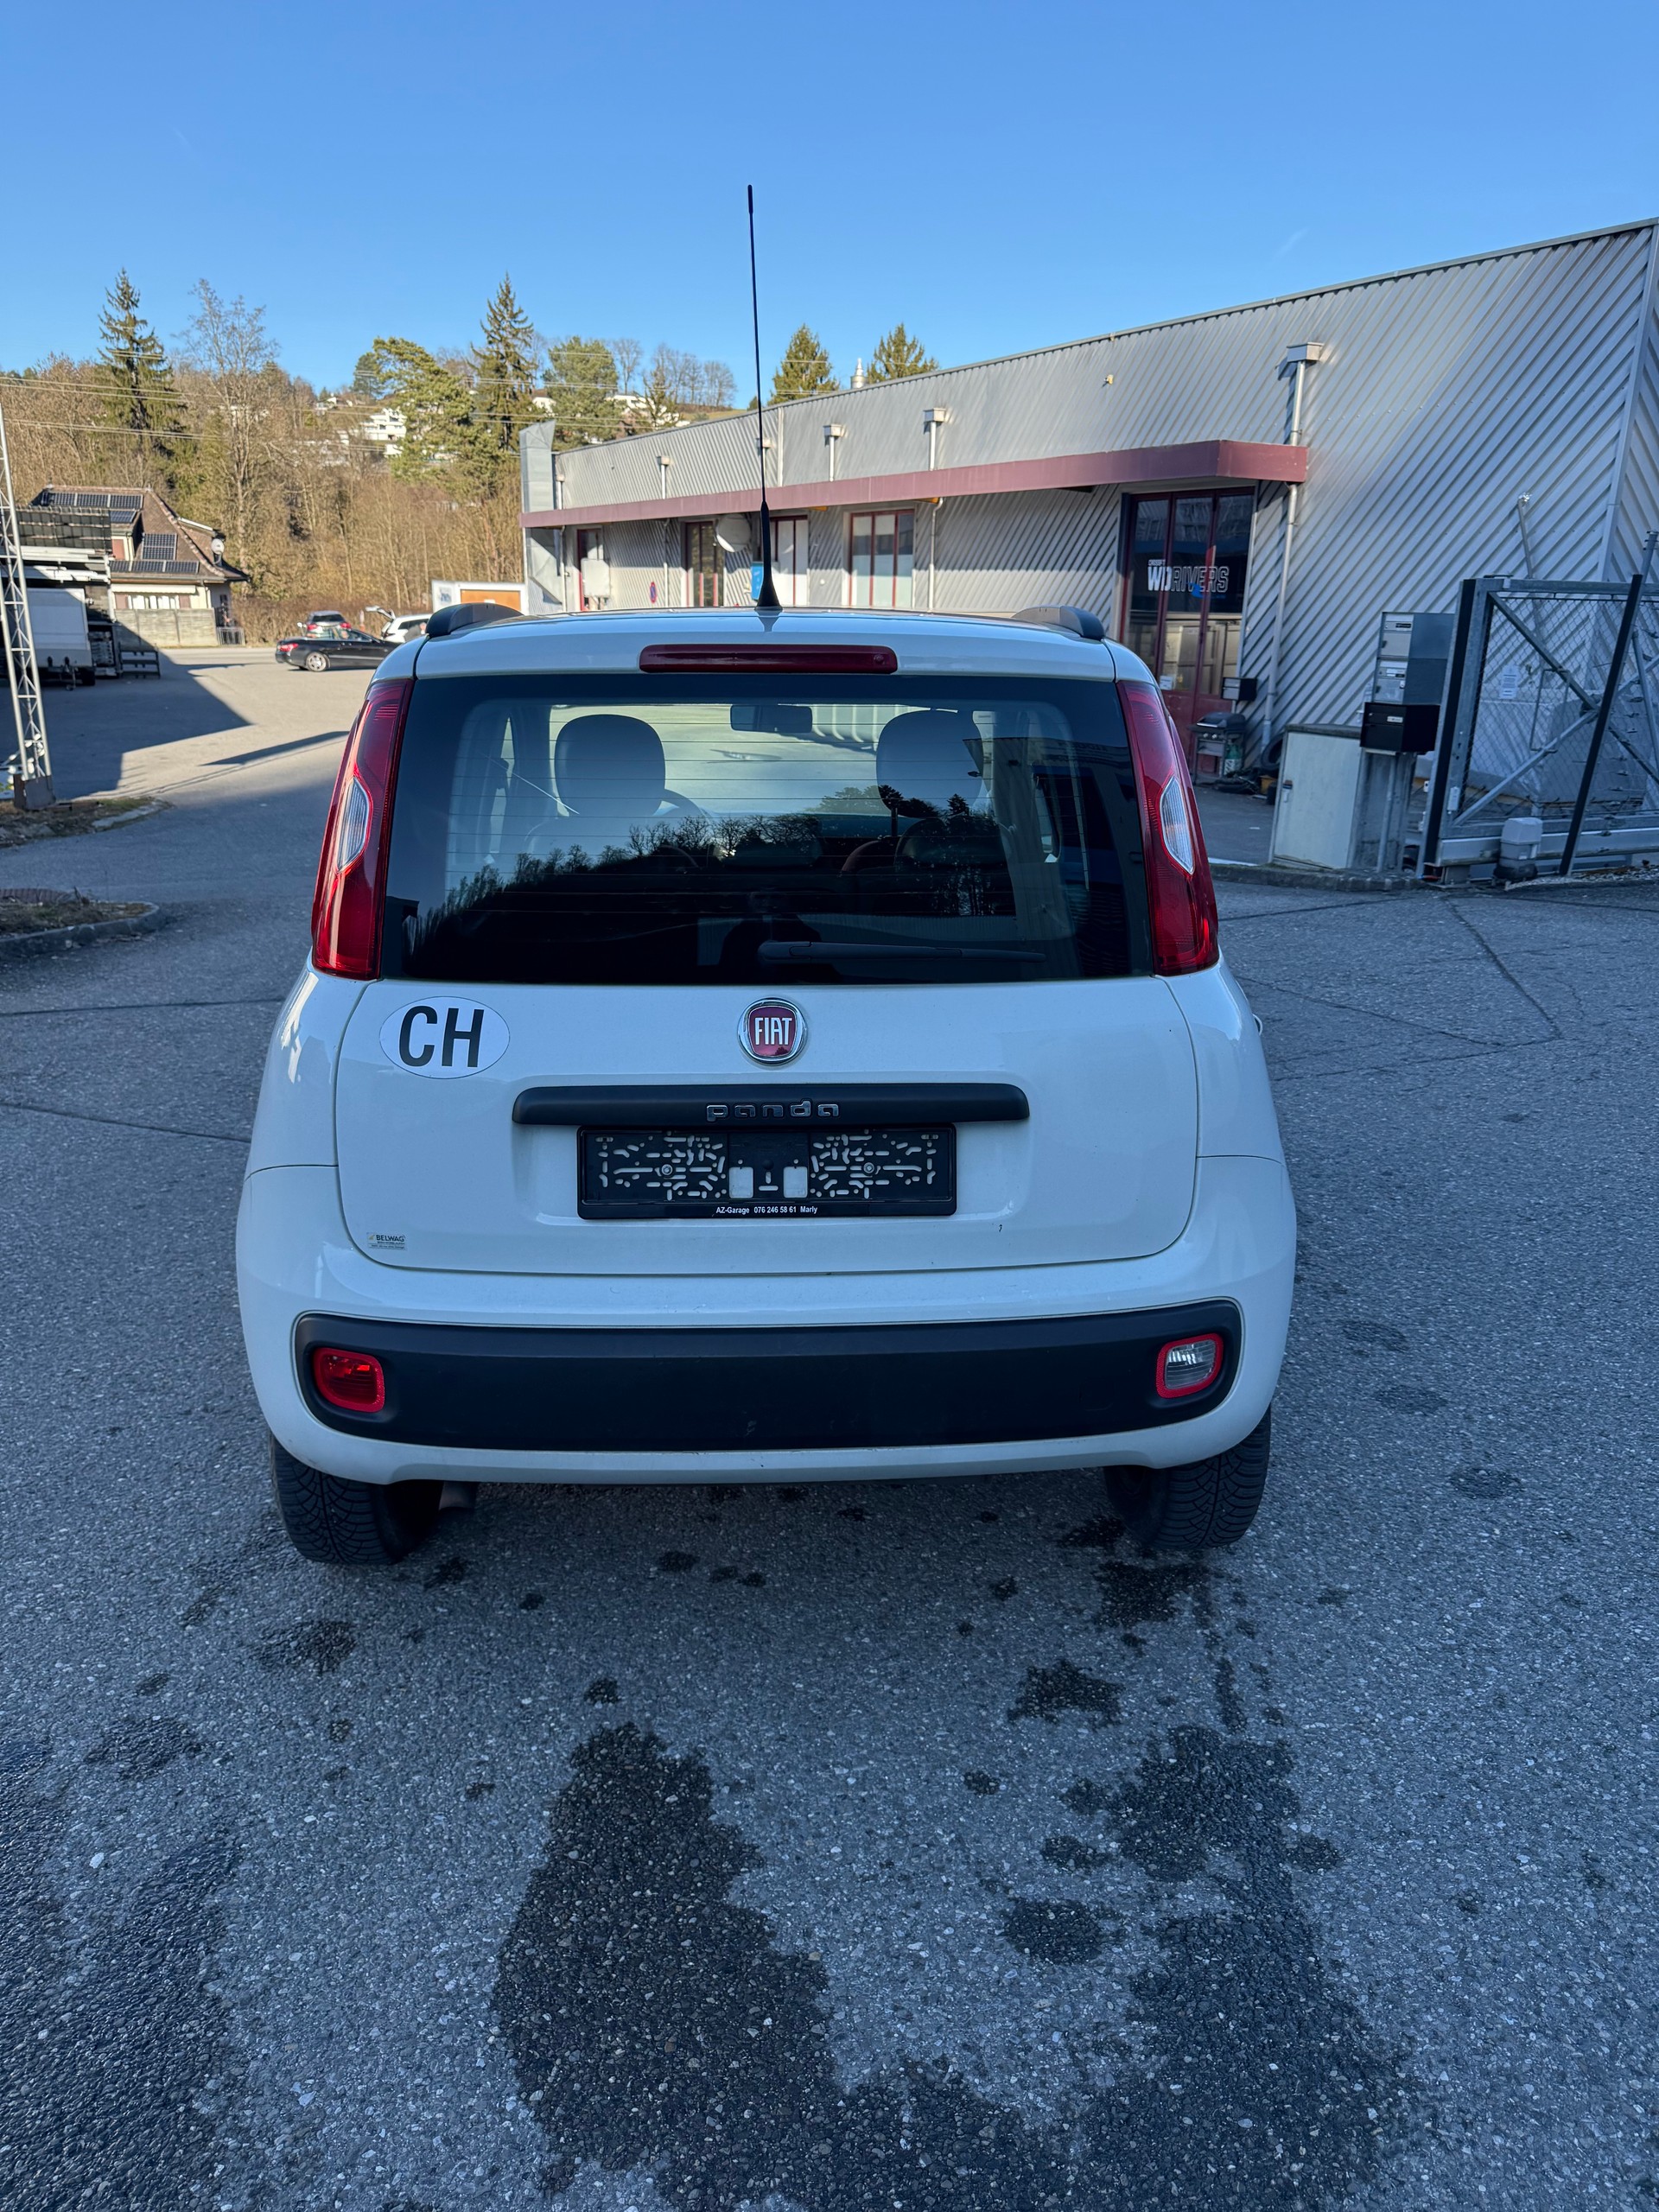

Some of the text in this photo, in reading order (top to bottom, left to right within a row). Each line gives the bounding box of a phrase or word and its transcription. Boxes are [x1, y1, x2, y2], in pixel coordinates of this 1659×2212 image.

[398, 1005, 485, 1068] CH
[754, 1017, 792, 1046] FIAT
[706, 1099, 839, 1122] panda
[715, 1206, 750, 1215] AZ-Garage
[800, 1205, 818, 1214] Marly
